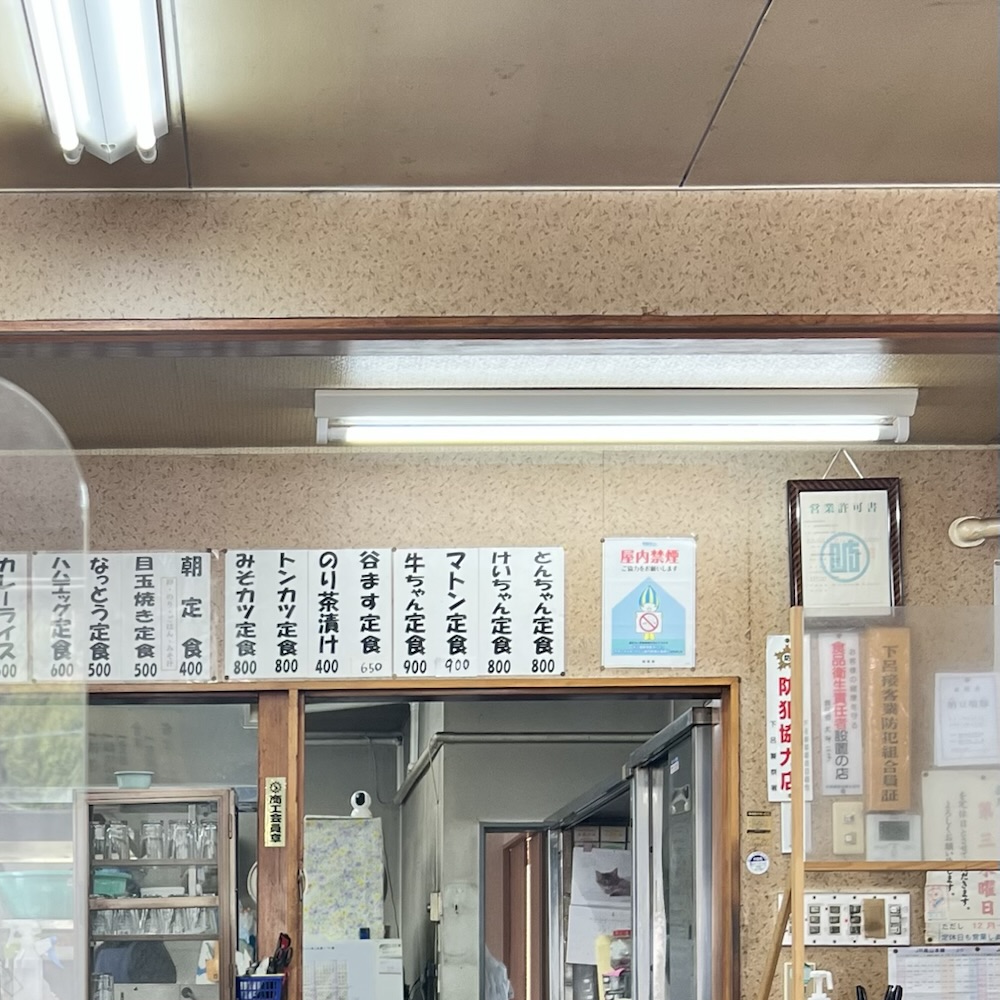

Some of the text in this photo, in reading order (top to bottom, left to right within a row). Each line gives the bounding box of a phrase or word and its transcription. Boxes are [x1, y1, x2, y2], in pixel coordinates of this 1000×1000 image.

[809, 502, 878, 514] 営業許可書
[620, 549, 679, 565] 屋内禁煙
[621, 565, 678, 573] ご協力をお願いします
[89, 557, 111, 660] なっとう定食
[134, 556, 155, 659] 目玉焼き定食
[180, 556, 203, 659] 朝定食
[235, 552, 256, 656] みそカツ定食
[277, 552, 298, 656] トンカツ定食
[318, 551, 339, 655] のり茶漬け
[359, 551, 381, 655] 谷ます定食
[404, 552, 426, 656] 牛ちゃん定食
[446, 551, 468, 656] マトン定食
[490, 551, 512, 655] けいちゃん定食
[532, 551, 554, 655] とんちゃん定食
[50, 662, 74, 677] 600
[88, 662, 111, 677] 500
[134, 663, 157, 677] 500
[179, 661, 203, 676] 400
[233, 660, 257, 675] 800
[274, 659, 298, 673] 800
[315, 659, 339, 674] 400
[360, 662, 382, 675] 650
[403, 660, 427, 674] 900
[445, 659, 470, 673] 900
[487, 659, 511, 674] 800
[531, 659, 555, 674] 800
[831, 641, 849, 781] 食品衛生責任者設置の店
